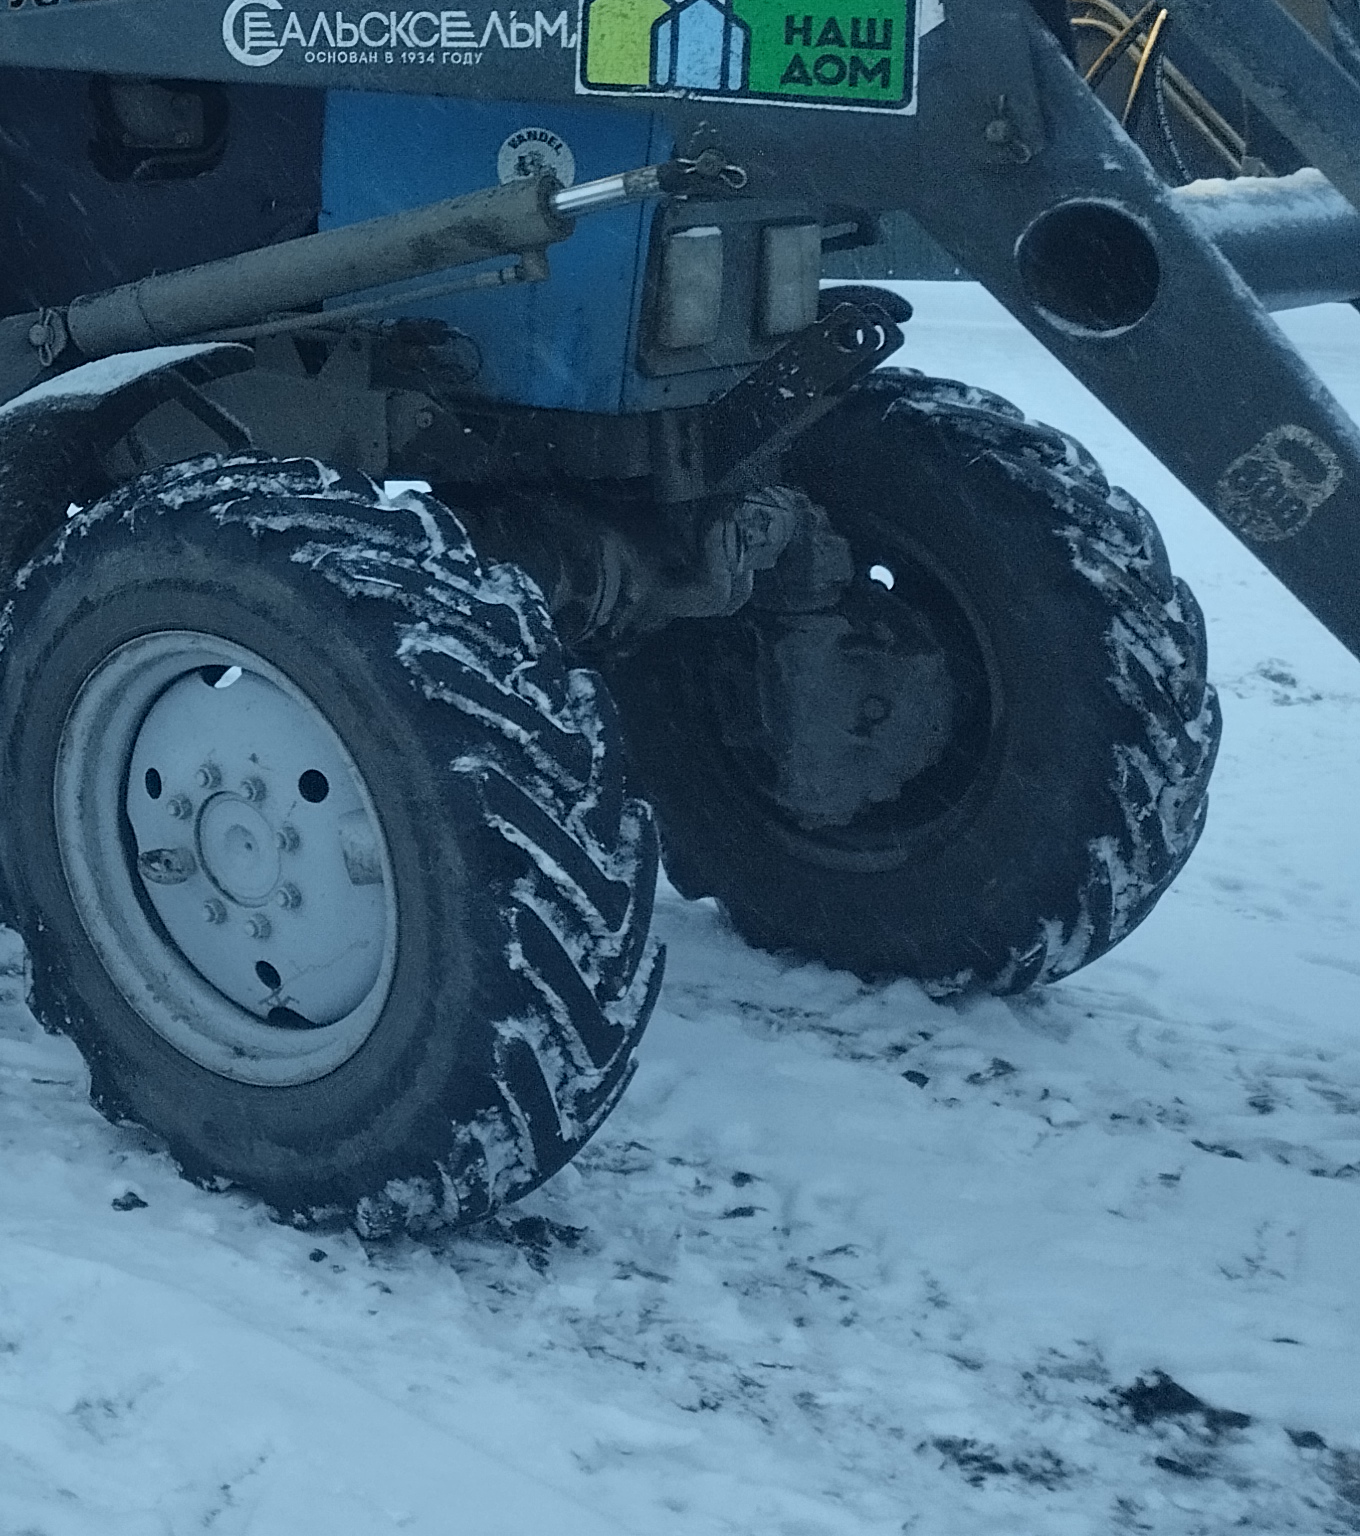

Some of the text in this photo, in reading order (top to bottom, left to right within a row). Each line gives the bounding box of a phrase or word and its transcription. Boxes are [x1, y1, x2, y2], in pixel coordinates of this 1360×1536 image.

[784, 14, 893, 50] НАШ
[304, 51, 483, 65] ОСНОВАН В 1934 ГОДУ
[779, 53, 891, 89] ДОМ
